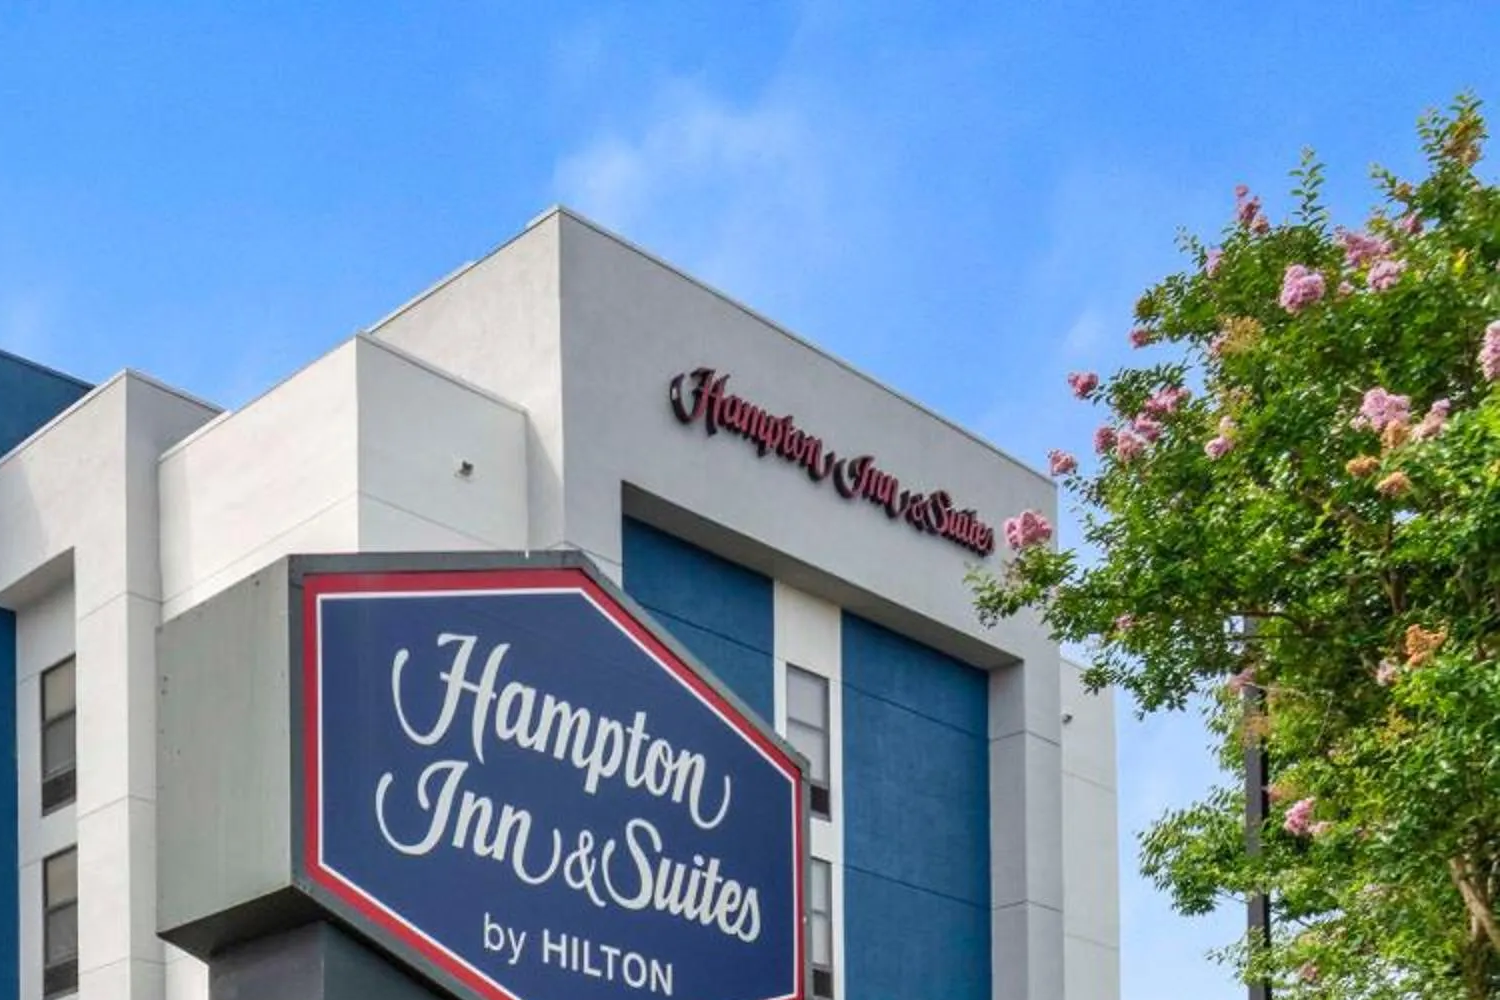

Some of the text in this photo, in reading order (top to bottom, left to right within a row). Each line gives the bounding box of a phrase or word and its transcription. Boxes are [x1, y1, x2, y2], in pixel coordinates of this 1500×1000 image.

[669, 367, 835, 482] Hampton
[833, 455, 911, 519] Inn
[922, 490, 995, 557] Suites
[392, 632, 731, 829] Hampton
[375, 760, 561, 885] Inn
[602, 818, 761, 943] Suites
[483, 912, 674, 996] by HILTON
